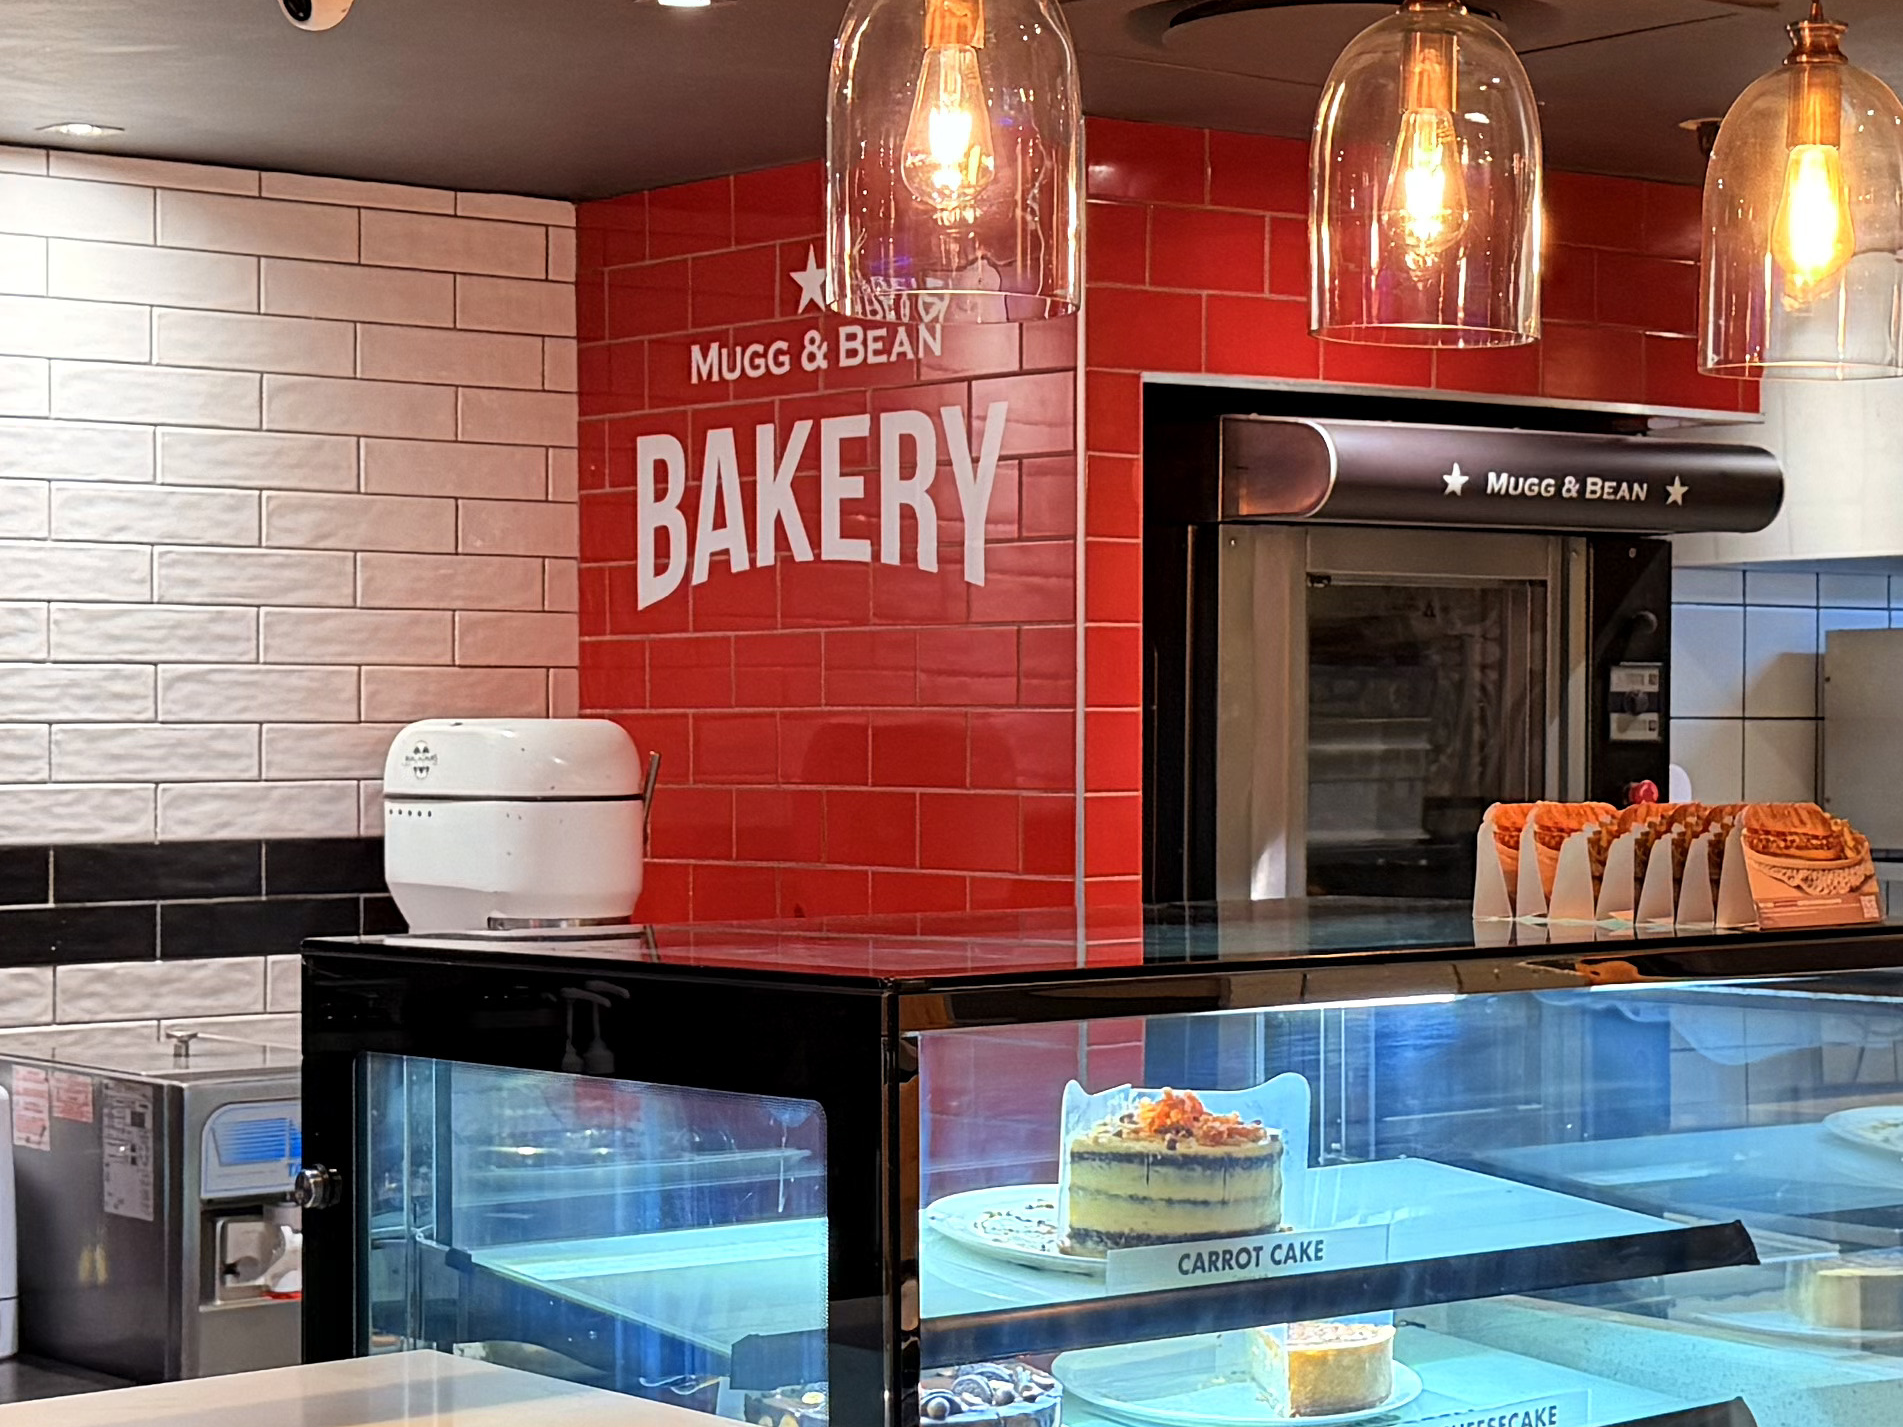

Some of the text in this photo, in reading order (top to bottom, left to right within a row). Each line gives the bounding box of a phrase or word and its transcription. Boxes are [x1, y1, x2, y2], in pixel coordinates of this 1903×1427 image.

[801, 329, 828, 371] &
[636, 401, 1009, 611] BAKERY
[1561, 475, 1580, 499] &
[1177, 1239, 1324, 1276] CARROT CAKE
